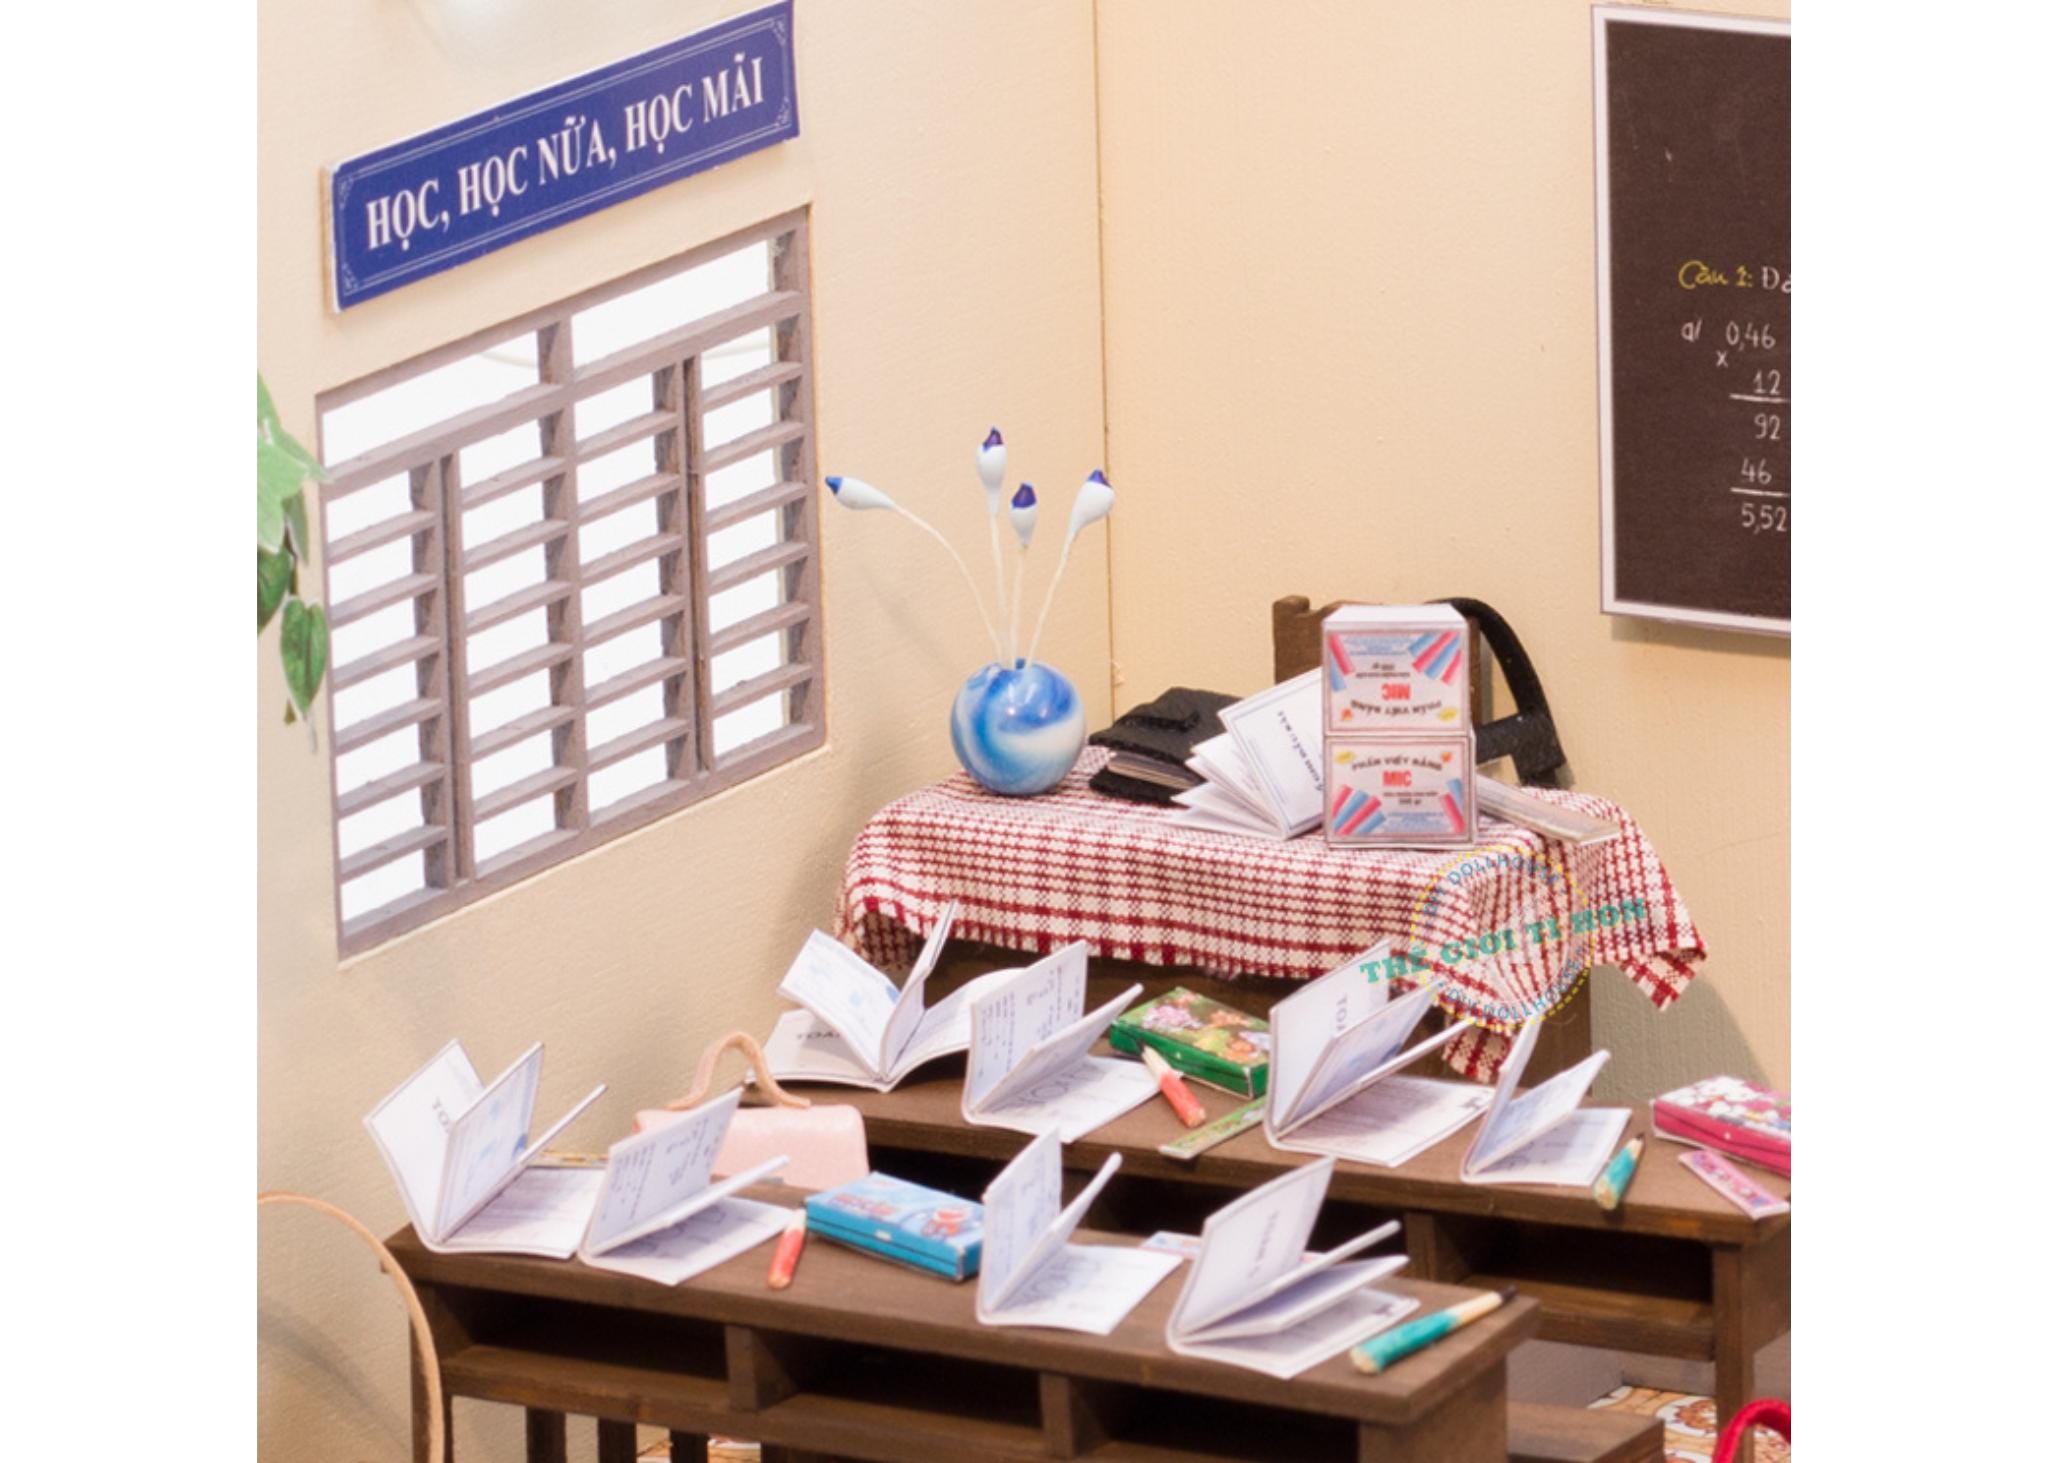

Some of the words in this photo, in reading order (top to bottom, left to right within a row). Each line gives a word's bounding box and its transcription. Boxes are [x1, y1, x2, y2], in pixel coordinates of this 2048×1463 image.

[366, 179, 450, 251] HỌC,
[457, 145, 528, 217] HỌC
[537, 116, 616, 185] NỮA,
[625, 84, 694, 154] HỌC
[702, 53, 765, 126] MÃI
[1725, 321, 1776, 352] 0,46
[1753, 369, 1781, 395] 12
[1754, 413, 1781, 440] 92
[1741, 458, 1772, 485] 46
[1741, 502, 1787, 534] 5,52
[1381, 683, 1411, 701] MIC
[1382, 770, 1412, 787] MIC
